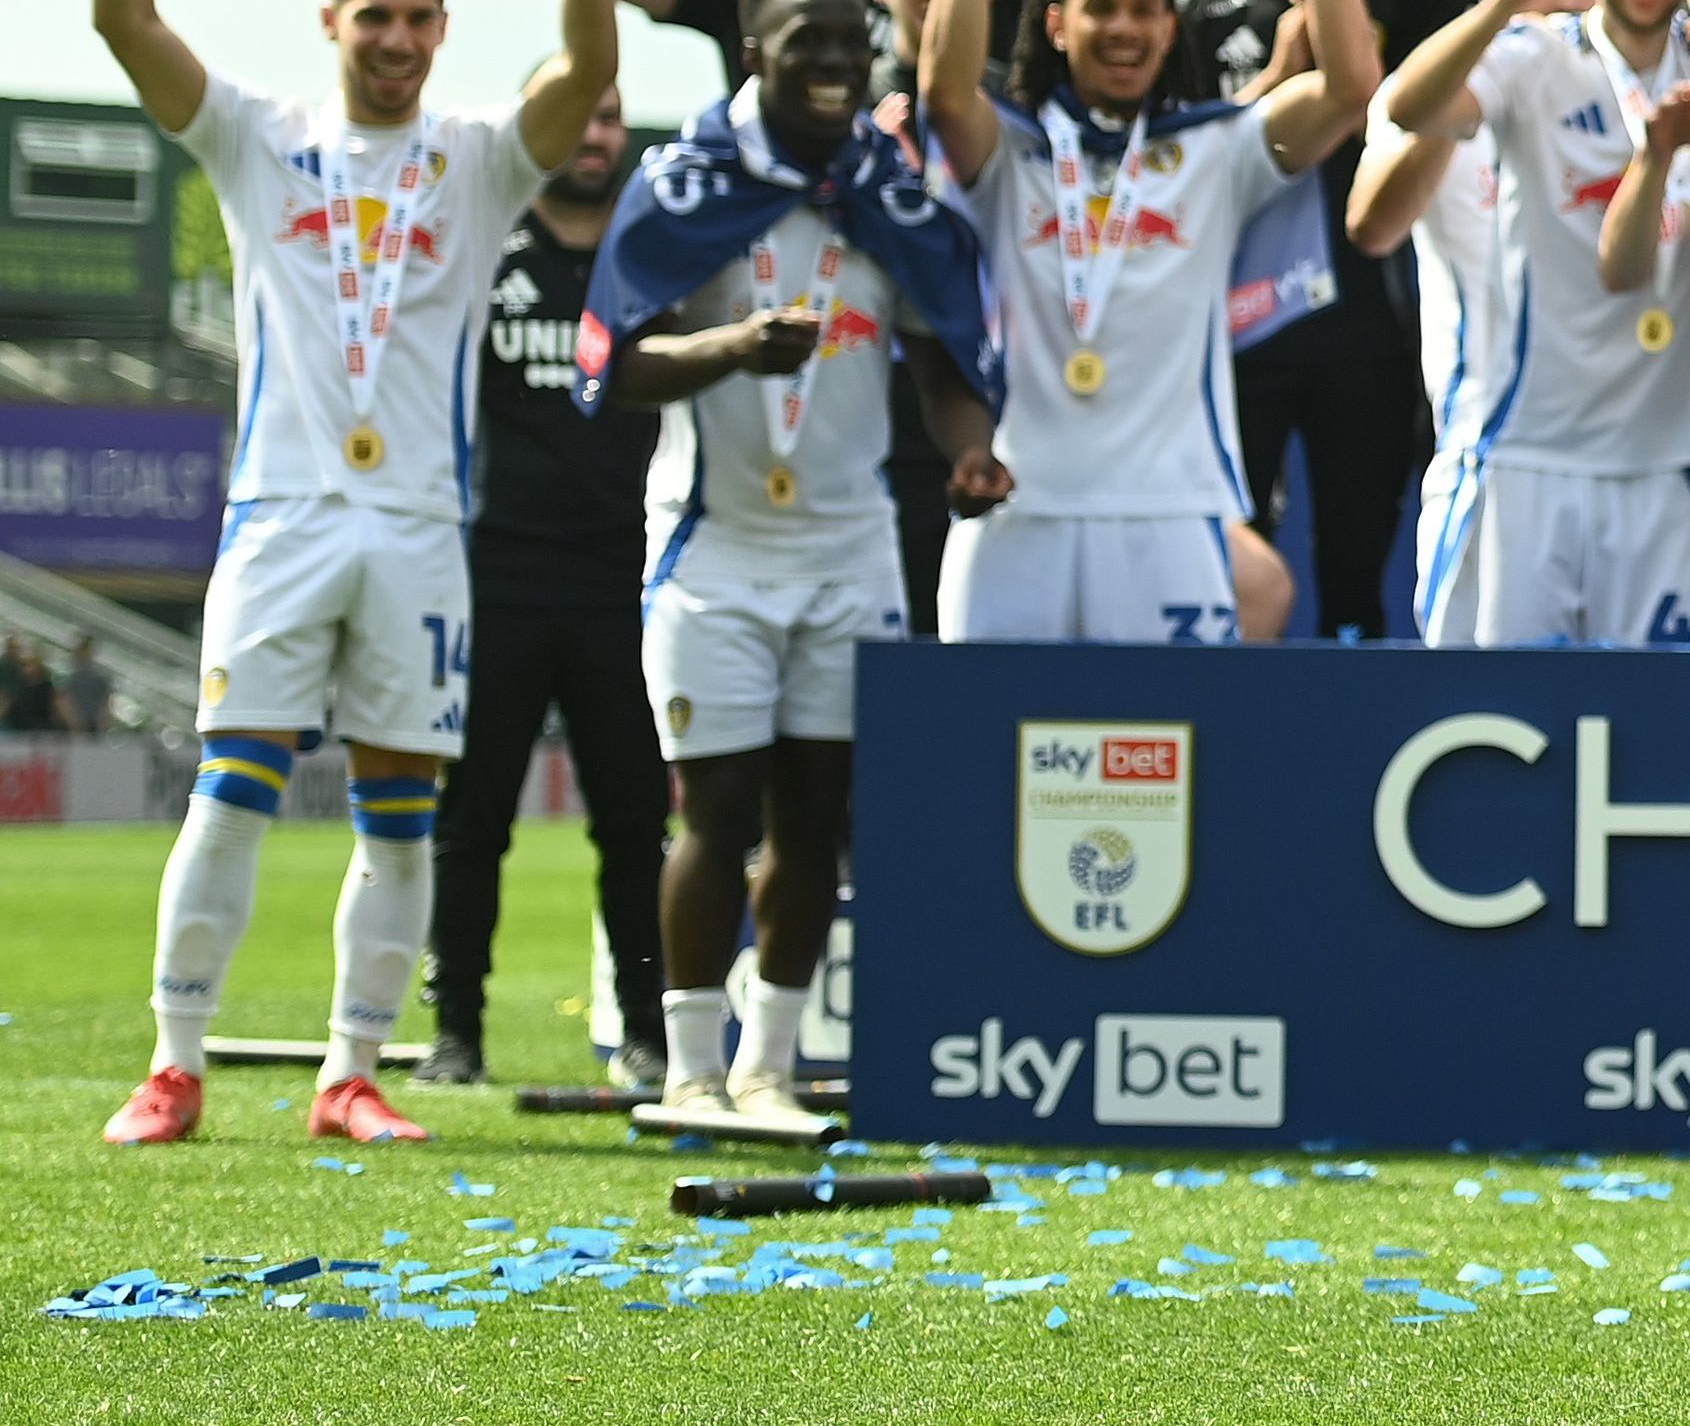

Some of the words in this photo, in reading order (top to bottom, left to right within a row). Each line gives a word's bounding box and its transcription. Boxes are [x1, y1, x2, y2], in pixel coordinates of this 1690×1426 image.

[1031, 738, 1095, 781] sky
[1107, 742, 1174, 776] bet
[1075, 902, 1129, 931] EFL
[930, 1016, 1084, 1119] sky
[1117, 1027, 1262, 1099] bet
